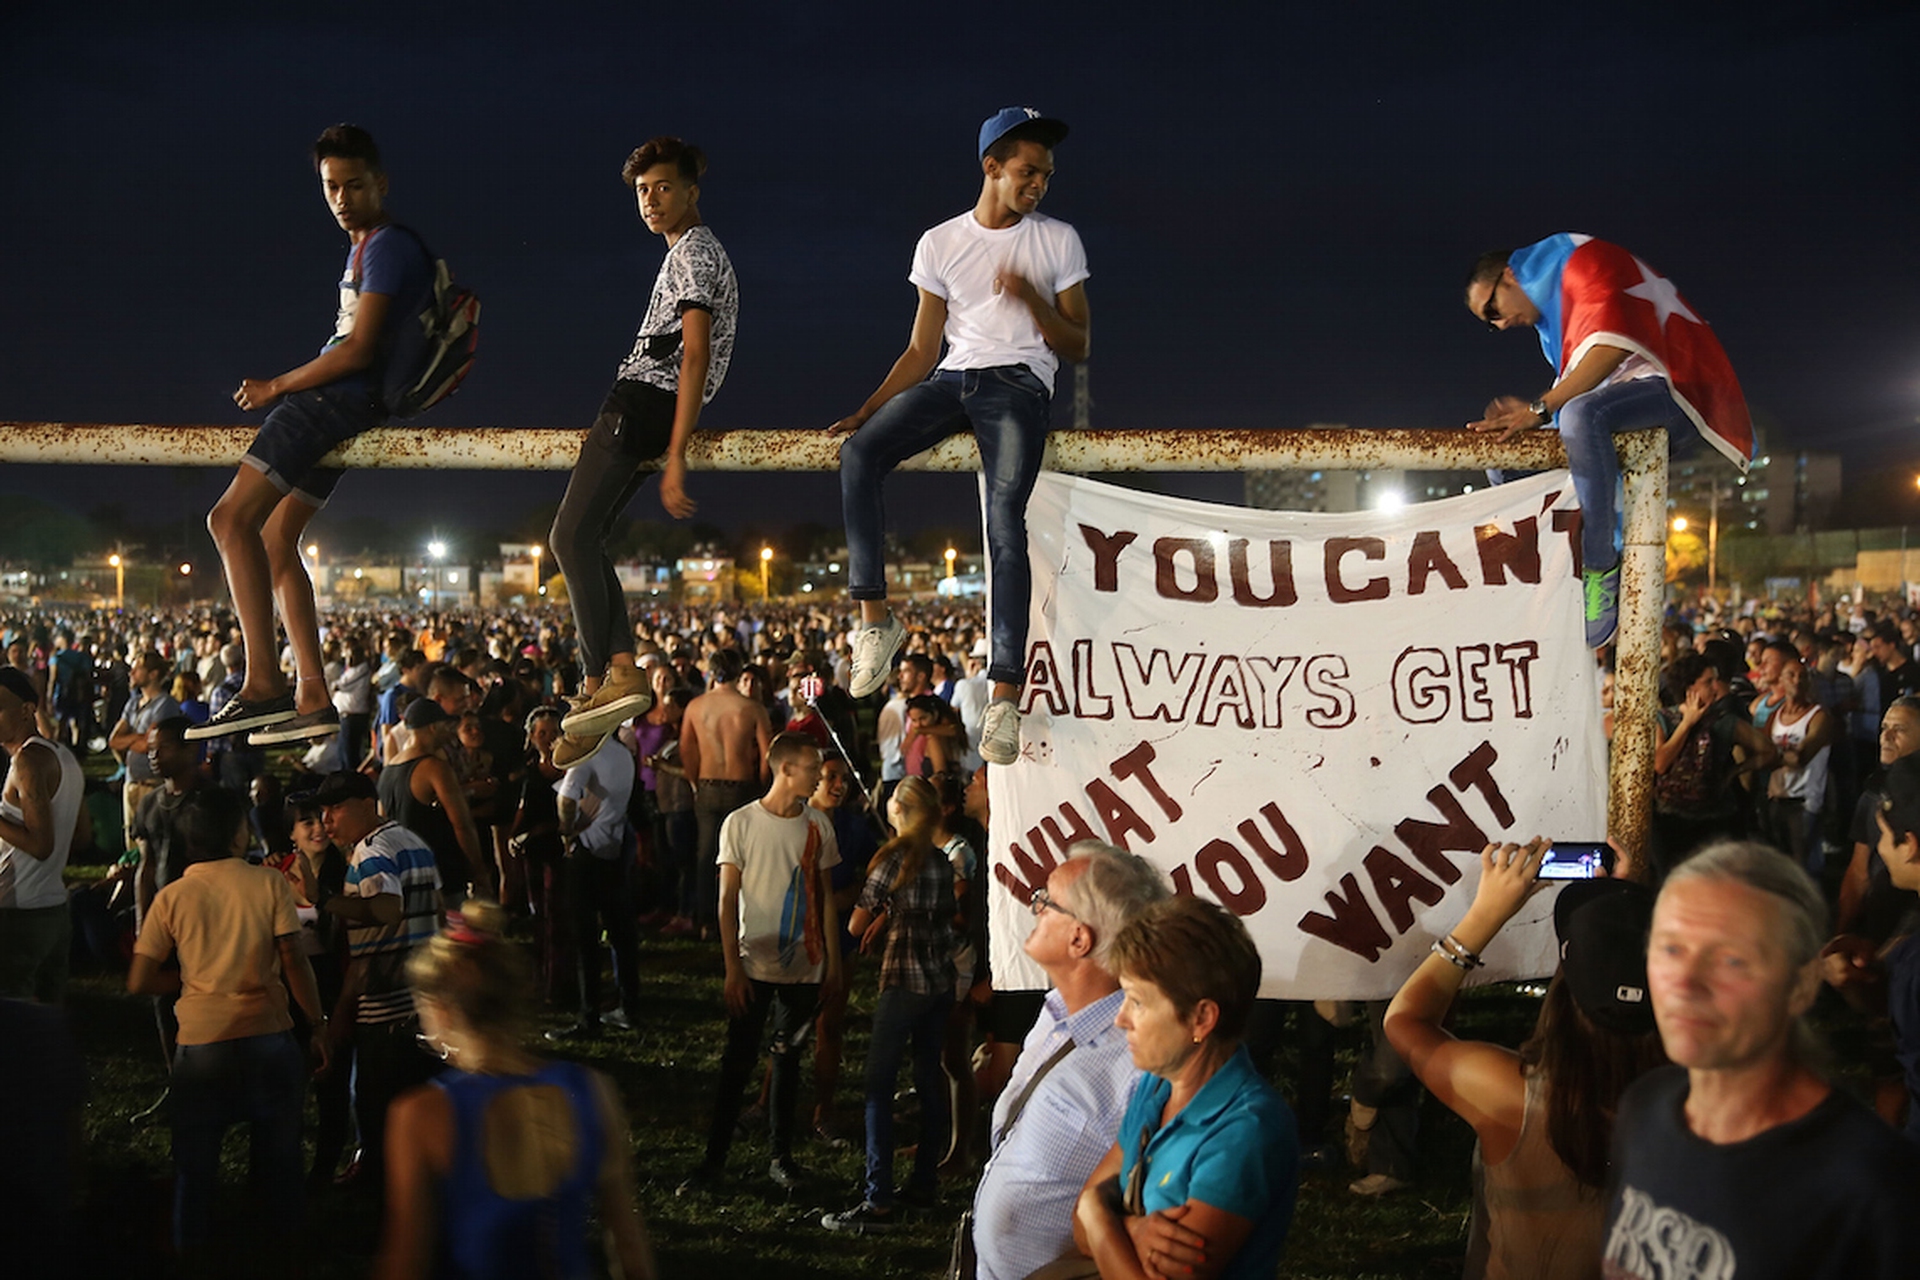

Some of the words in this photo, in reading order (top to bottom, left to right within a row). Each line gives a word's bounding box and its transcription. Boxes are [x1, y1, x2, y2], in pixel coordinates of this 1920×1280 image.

[1078, 523, 1297, 608] YOU
[1018, 639, 1356, 728] ALWAYS
[1391, 640, 1539, 724] GET
[1298, 741, 1515, 963] WANT
